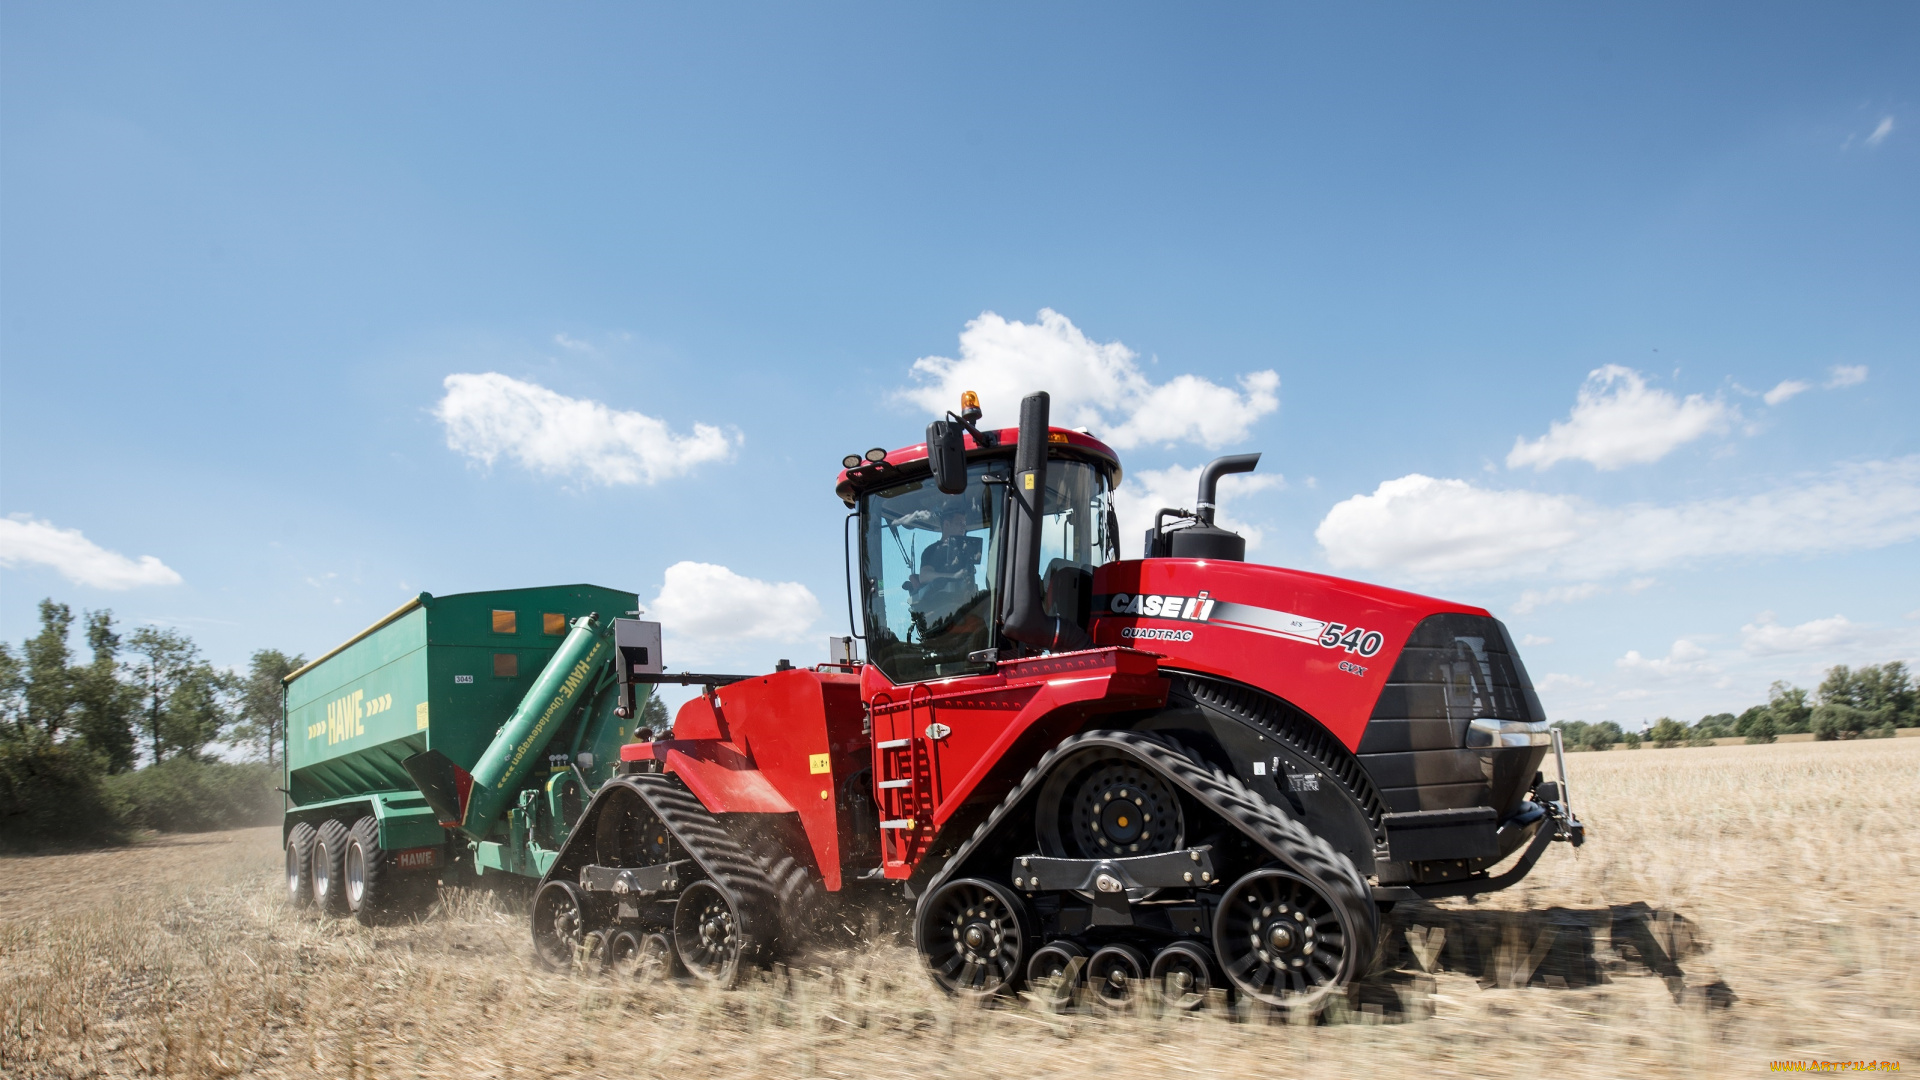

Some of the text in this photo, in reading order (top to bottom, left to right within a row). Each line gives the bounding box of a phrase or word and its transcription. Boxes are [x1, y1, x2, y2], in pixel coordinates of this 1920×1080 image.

[1110, 593, 1184, 618] CASE
[1121, 627, 1193, 642] QUADTRAC
[1319, 621, 1384, 657] 540
[1338, 660, 1368, 677] CVX
[327, 688, 364, 746] HAWE
[400, 851, 432, 867] HAWE
